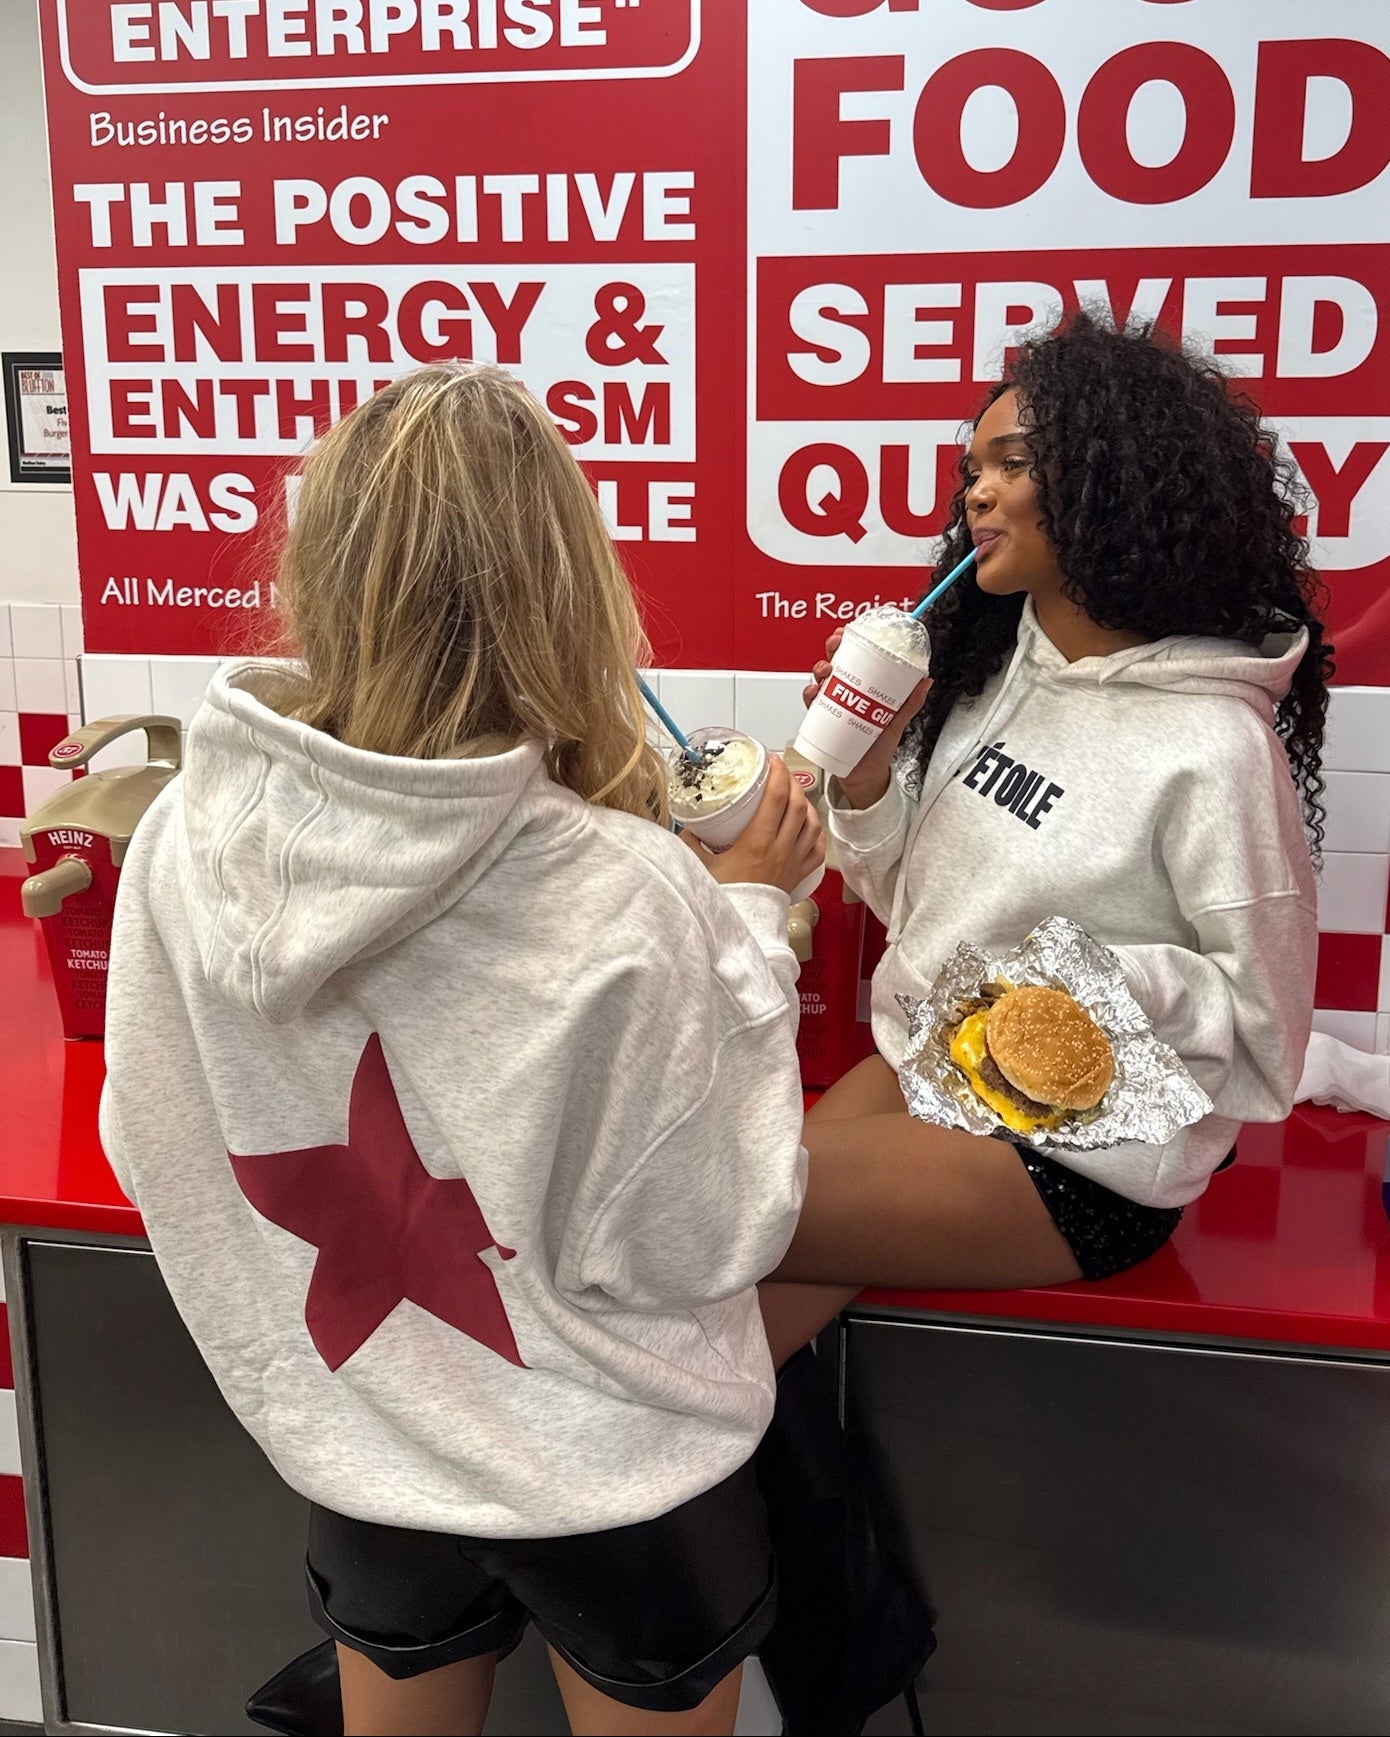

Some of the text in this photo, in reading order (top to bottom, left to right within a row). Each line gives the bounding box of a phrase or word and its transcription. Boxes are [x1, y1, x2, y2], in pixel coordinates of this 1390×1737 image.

[90, 105, 390, 147] Business Insider
[792, 38, 1390, 211] FOOD
[73, 171, 697, 248] THE POSITIVE
[102, 280, 671, 367] ENERGY &
[21, 378, 55, 393] BLUFFTON
[108, 378, 672, 445] ENTHSM
[93, 471, 259, 534] WAS
[101, 576, 140, 606] All
[147, 577, 260, 610] Merced
[755, 592, 808, 619] The
[831, 683, 871, 715] FIVE
[867, 686, 897, 706] SHAKES
[847, 718, 874, 736] SHAKES
[47, 830, 94, 848] HEINZ
[66, 958, 109, 970] KETCHU
[70, 949, 107, 959] TOMATO
